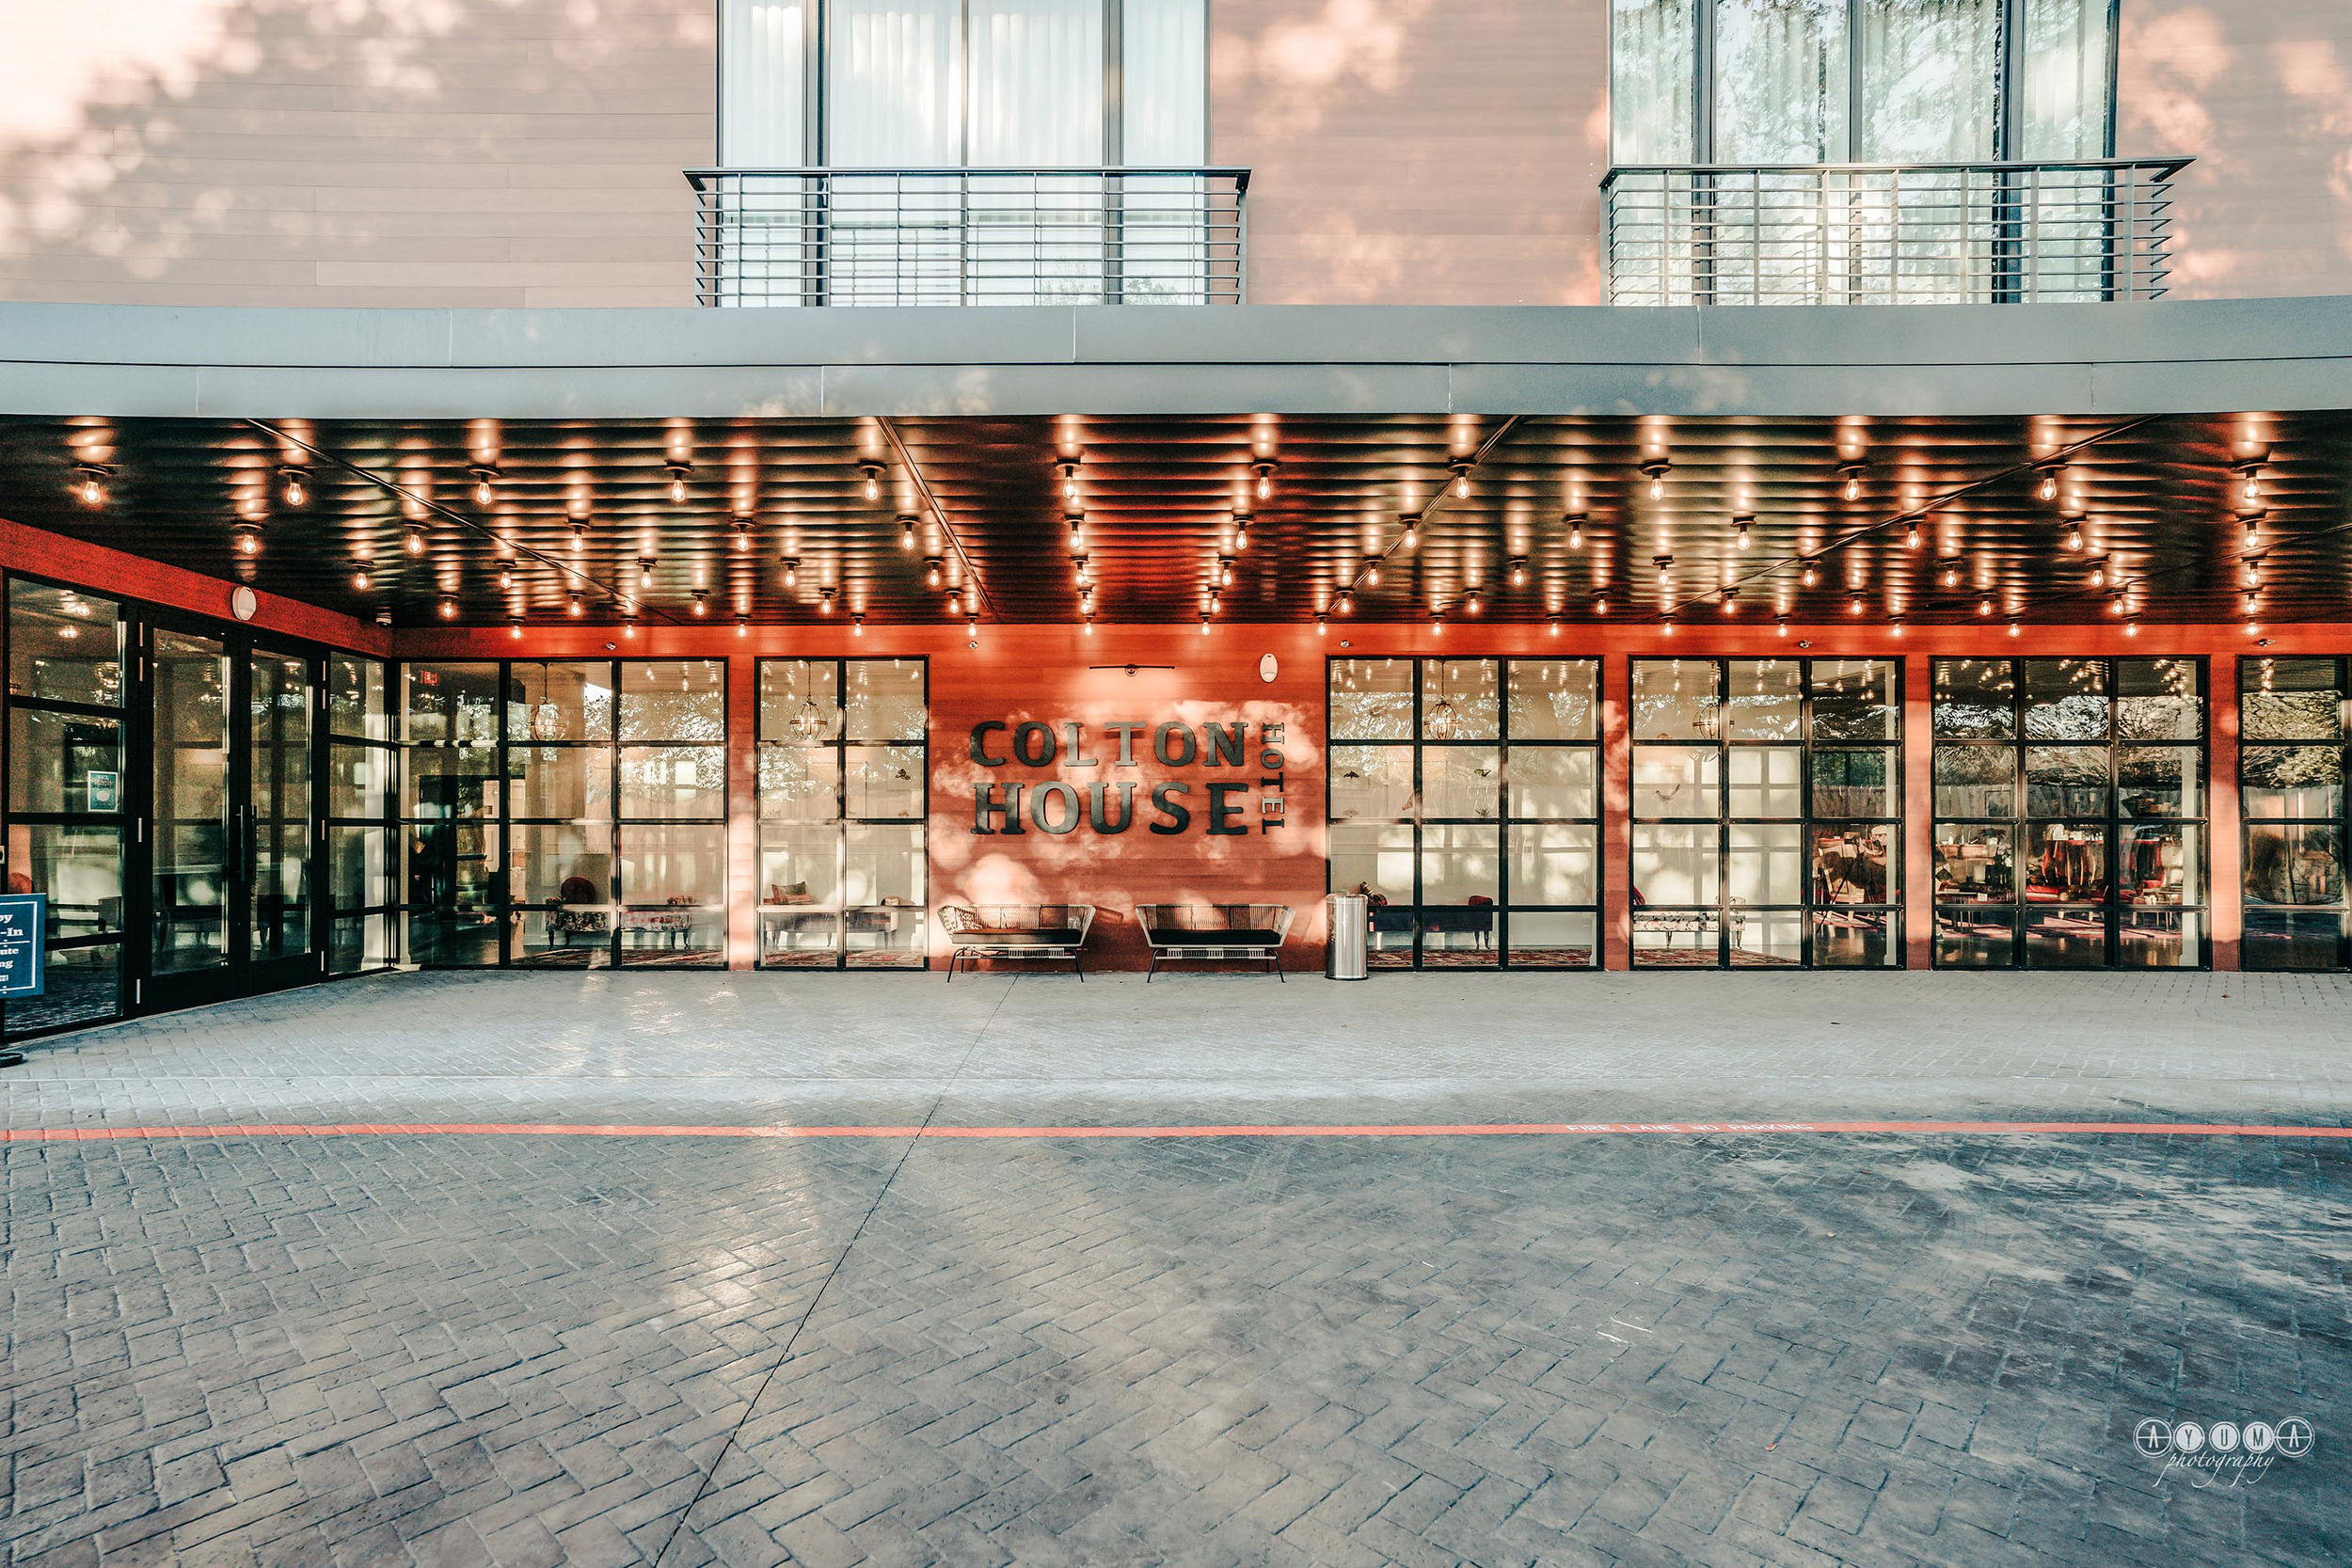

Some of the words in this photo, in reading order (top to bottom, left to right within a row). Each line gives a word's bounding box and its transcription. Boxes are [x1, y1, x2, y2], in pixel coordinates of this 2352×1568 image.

[970, 721, 1248, 767] COLTON
[1262, 722, 1284, 834] HOTEL
[971, 782, 1248, 835] HOUSE
